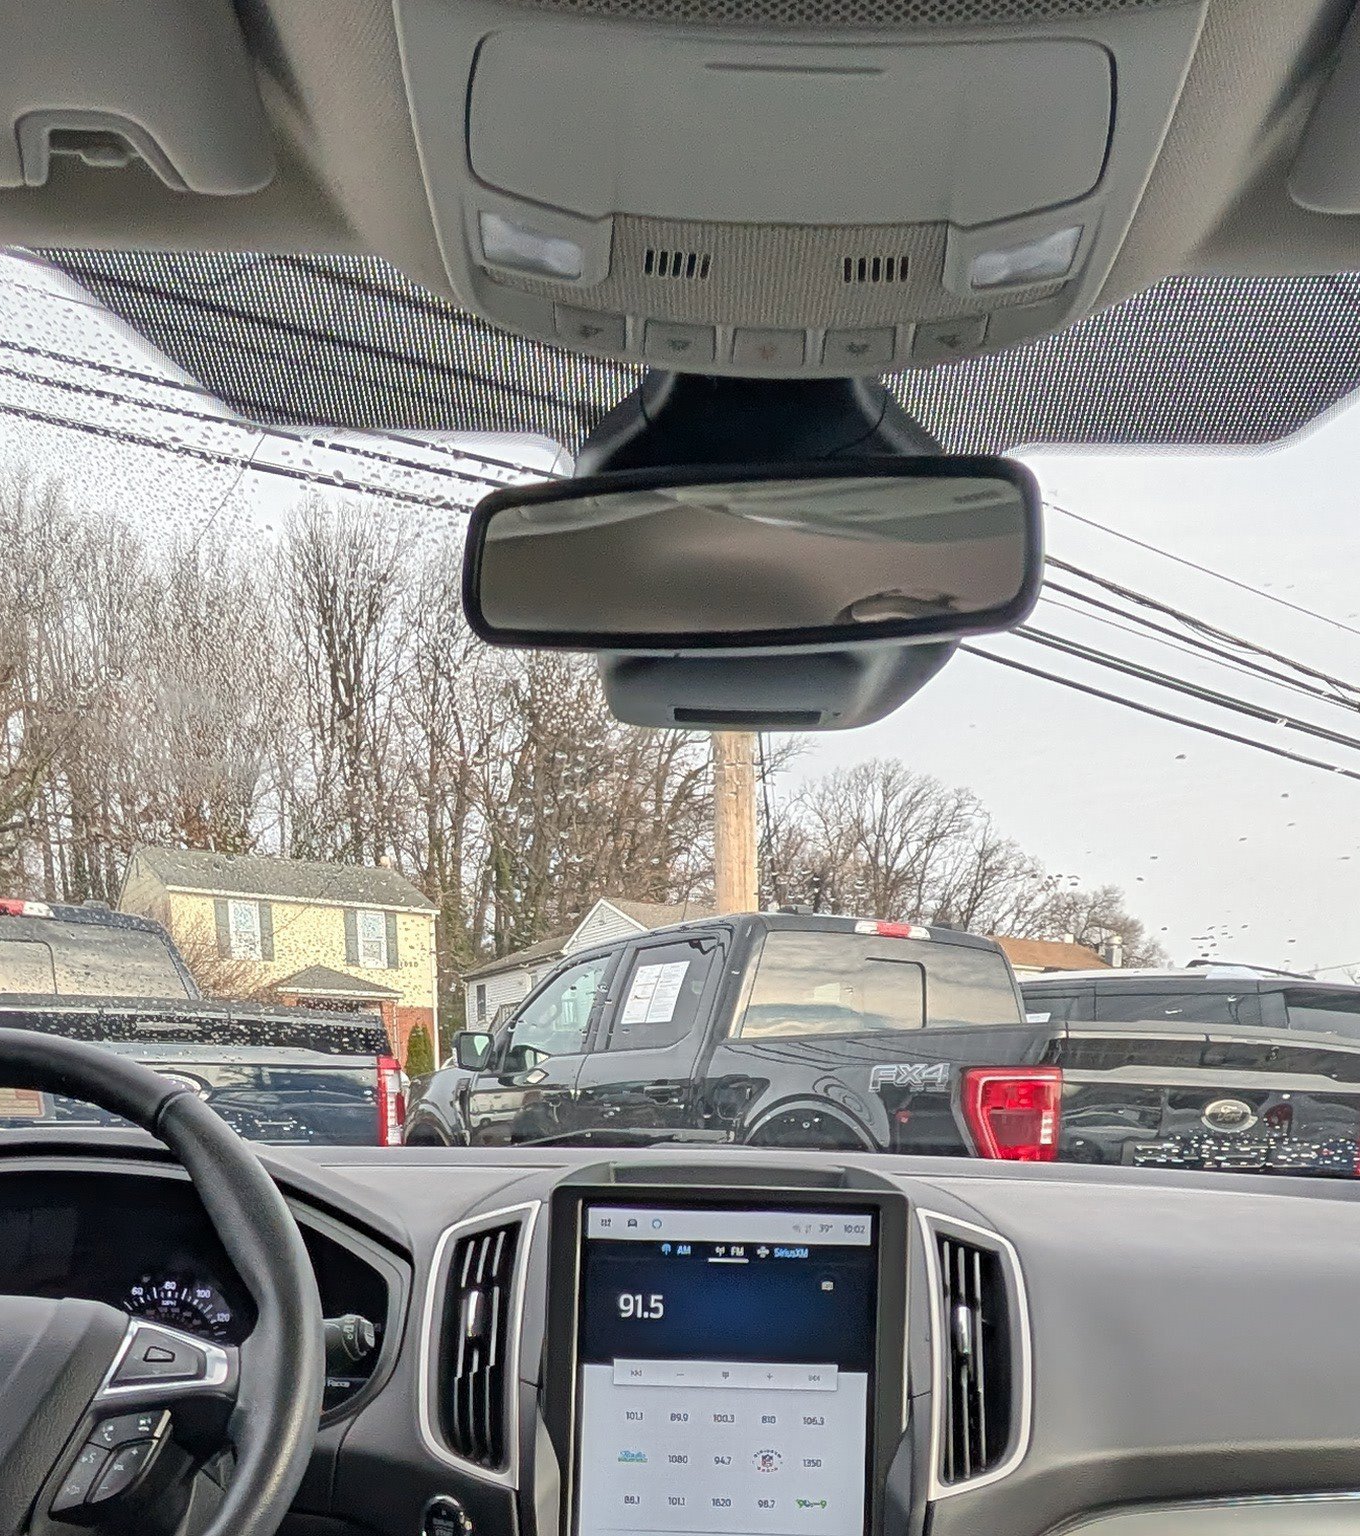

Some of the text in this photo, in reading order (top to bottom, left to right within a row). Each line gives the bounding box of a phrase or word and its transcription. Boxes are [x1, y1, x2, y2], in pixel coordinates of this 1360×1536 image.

[868, 1062, 950, 1092] FX4
[196, 1289, 211, 1299] 100
[617, 1293, 664, 1319] 91.5
[216, 1312, 230, 1322] 120
